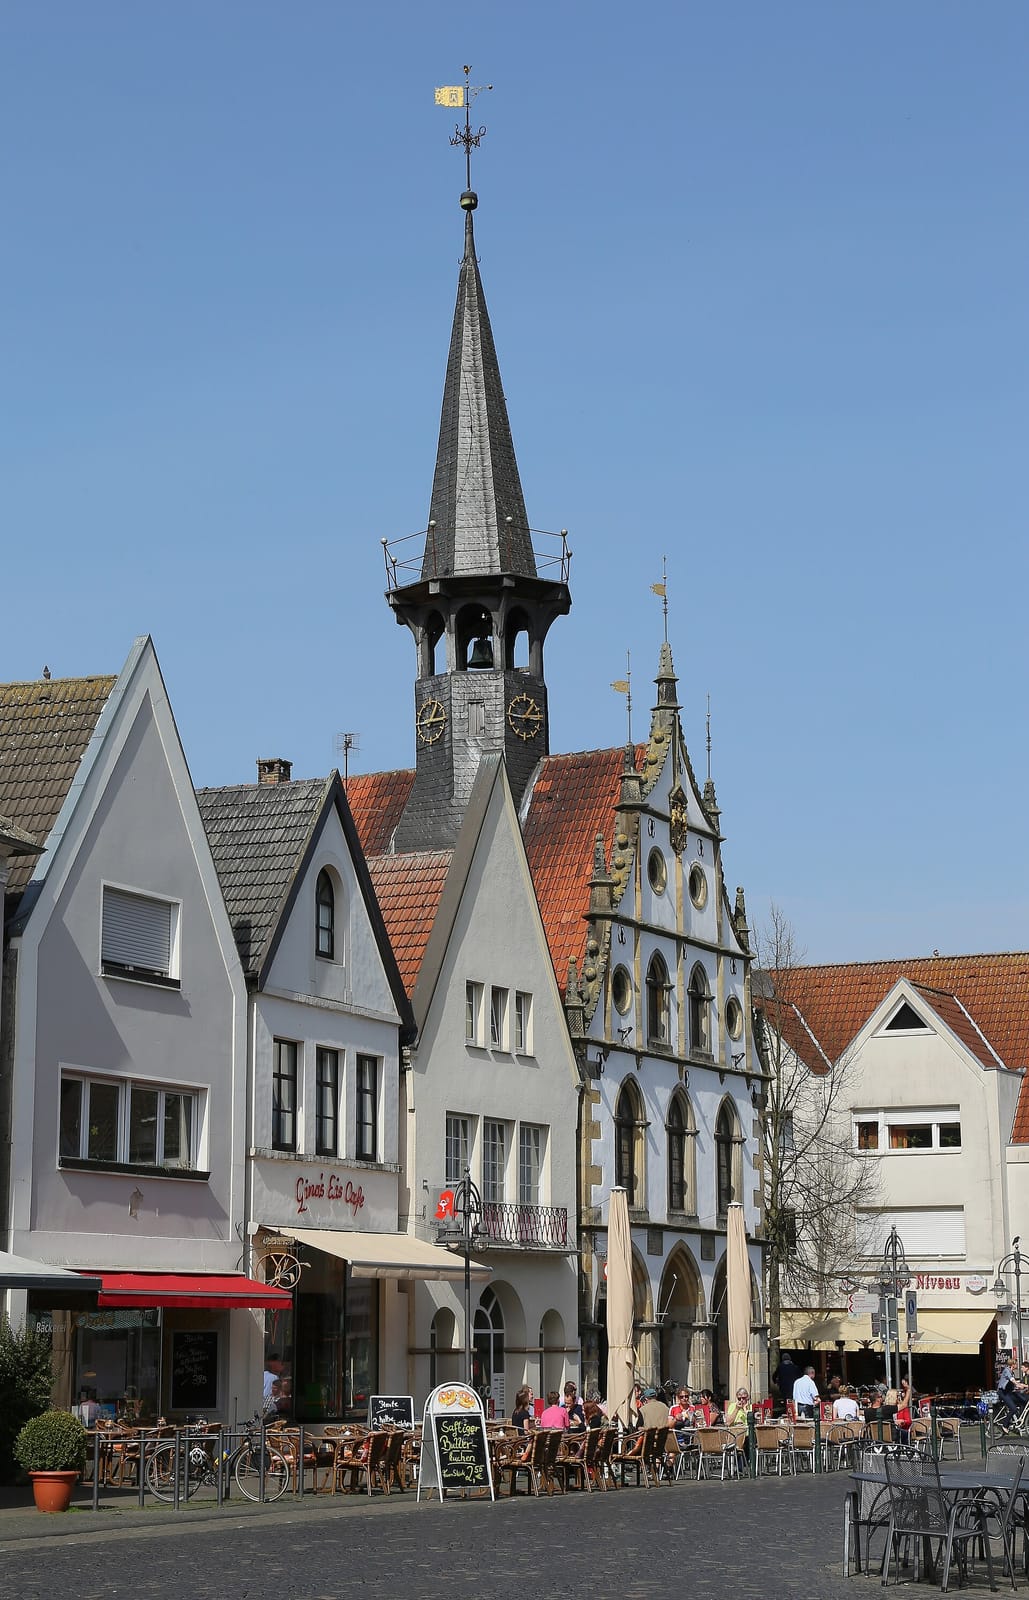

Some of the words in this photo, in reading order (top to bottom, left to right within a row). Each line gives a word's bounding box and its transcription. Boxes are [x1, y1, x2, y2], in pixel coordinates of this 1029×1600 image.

[328, 1175, 343, 1200] Eis
[915, 1274, 960, 1290] Niveau
[441, 1421, 480, 1437] Saftiger
